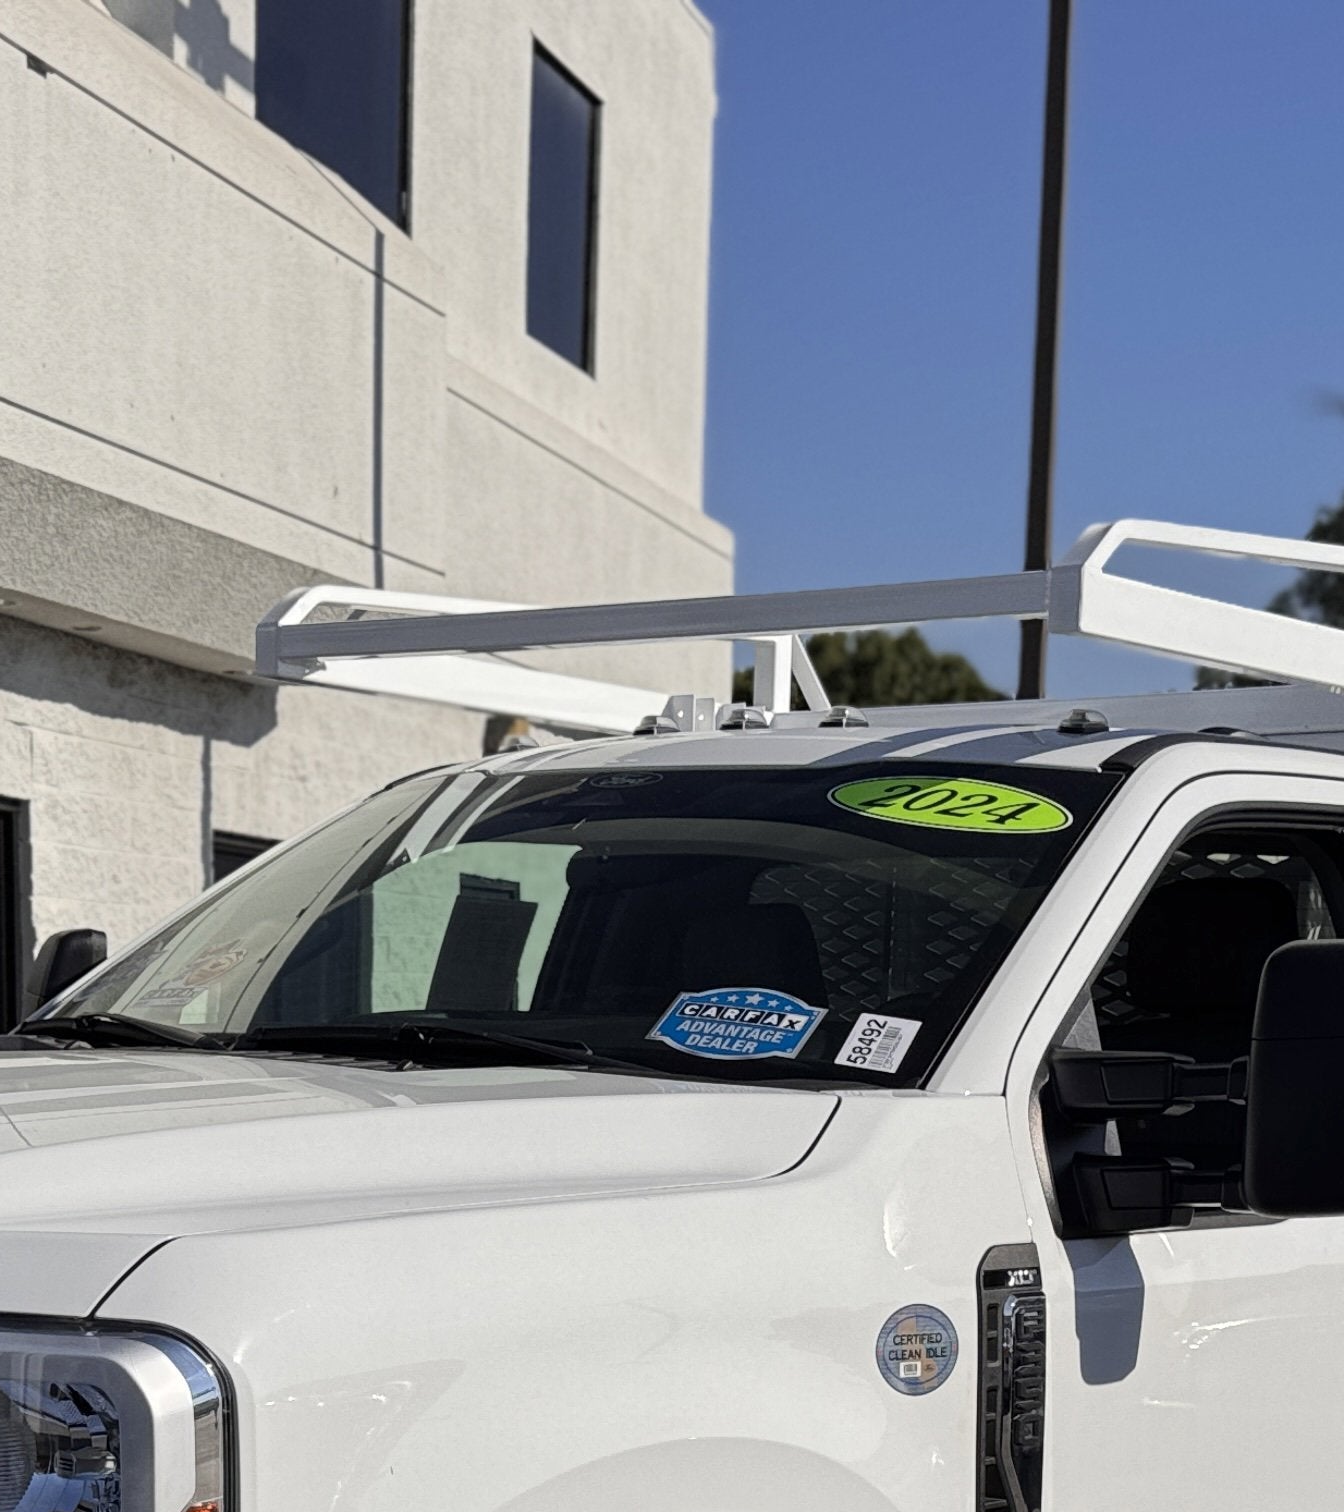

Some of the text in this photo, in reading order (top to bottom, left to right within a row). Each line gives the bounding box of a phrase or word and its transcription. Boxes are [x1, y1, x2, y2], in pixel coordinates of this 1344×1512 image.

[858, 784, 1041, 825] 2024
[681, 1002, 806, 1031] CARFAX
[676, 1019, 785, 1044] ADVANTAGE
[685, 1034, 758, 1054] DEALER
[846, 1019, 888, 1065] 58492
[892, 1332, 943, 1346] CERTIFIED
[888, 1346, 948, 1361] CLEAN IDLE
